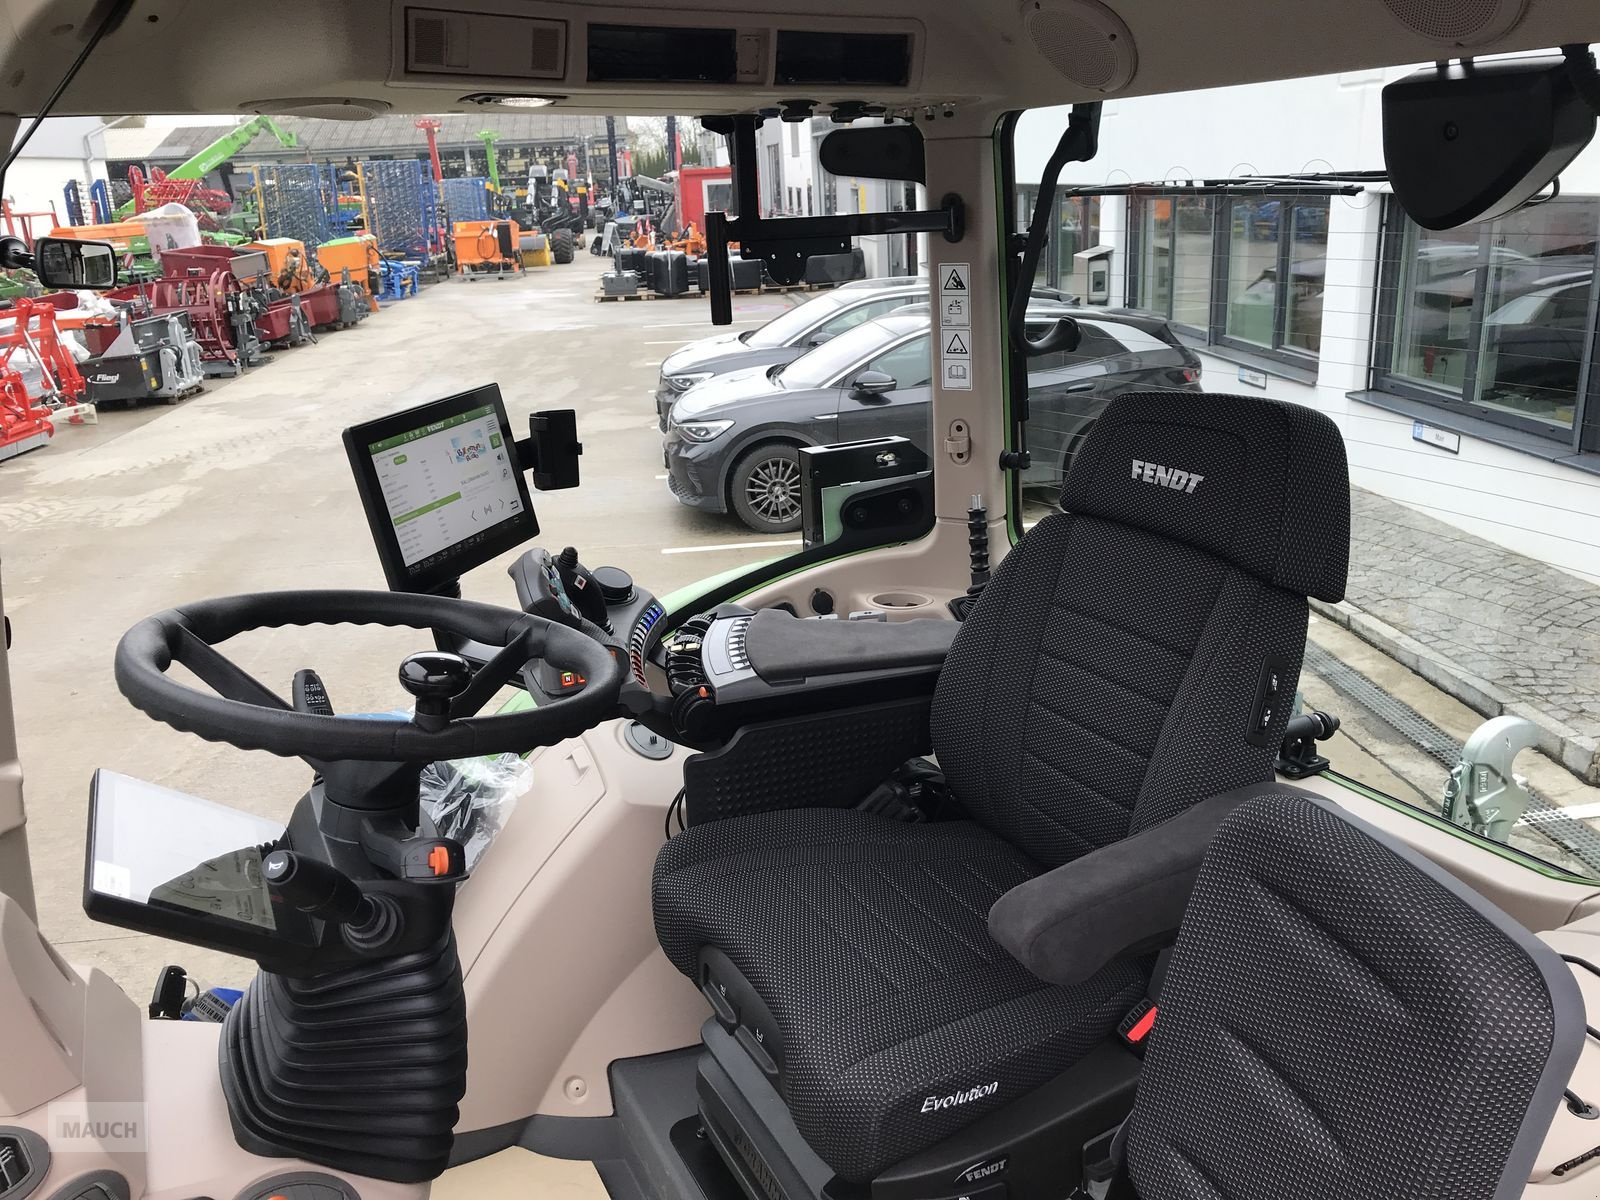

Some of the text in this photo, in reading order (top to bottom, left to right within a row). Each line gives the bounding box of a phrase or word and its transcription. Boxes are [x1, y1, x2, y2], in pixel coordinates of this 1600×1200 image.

[96, 373, 120, 384] Fliegl
[426, 420, 445, 433] FENDT
[1131, 459, 1205, 494] FENDT
[920, 1081, 999, 1113] Evolution
[965, 1159, 1007, 1182] FENDT
